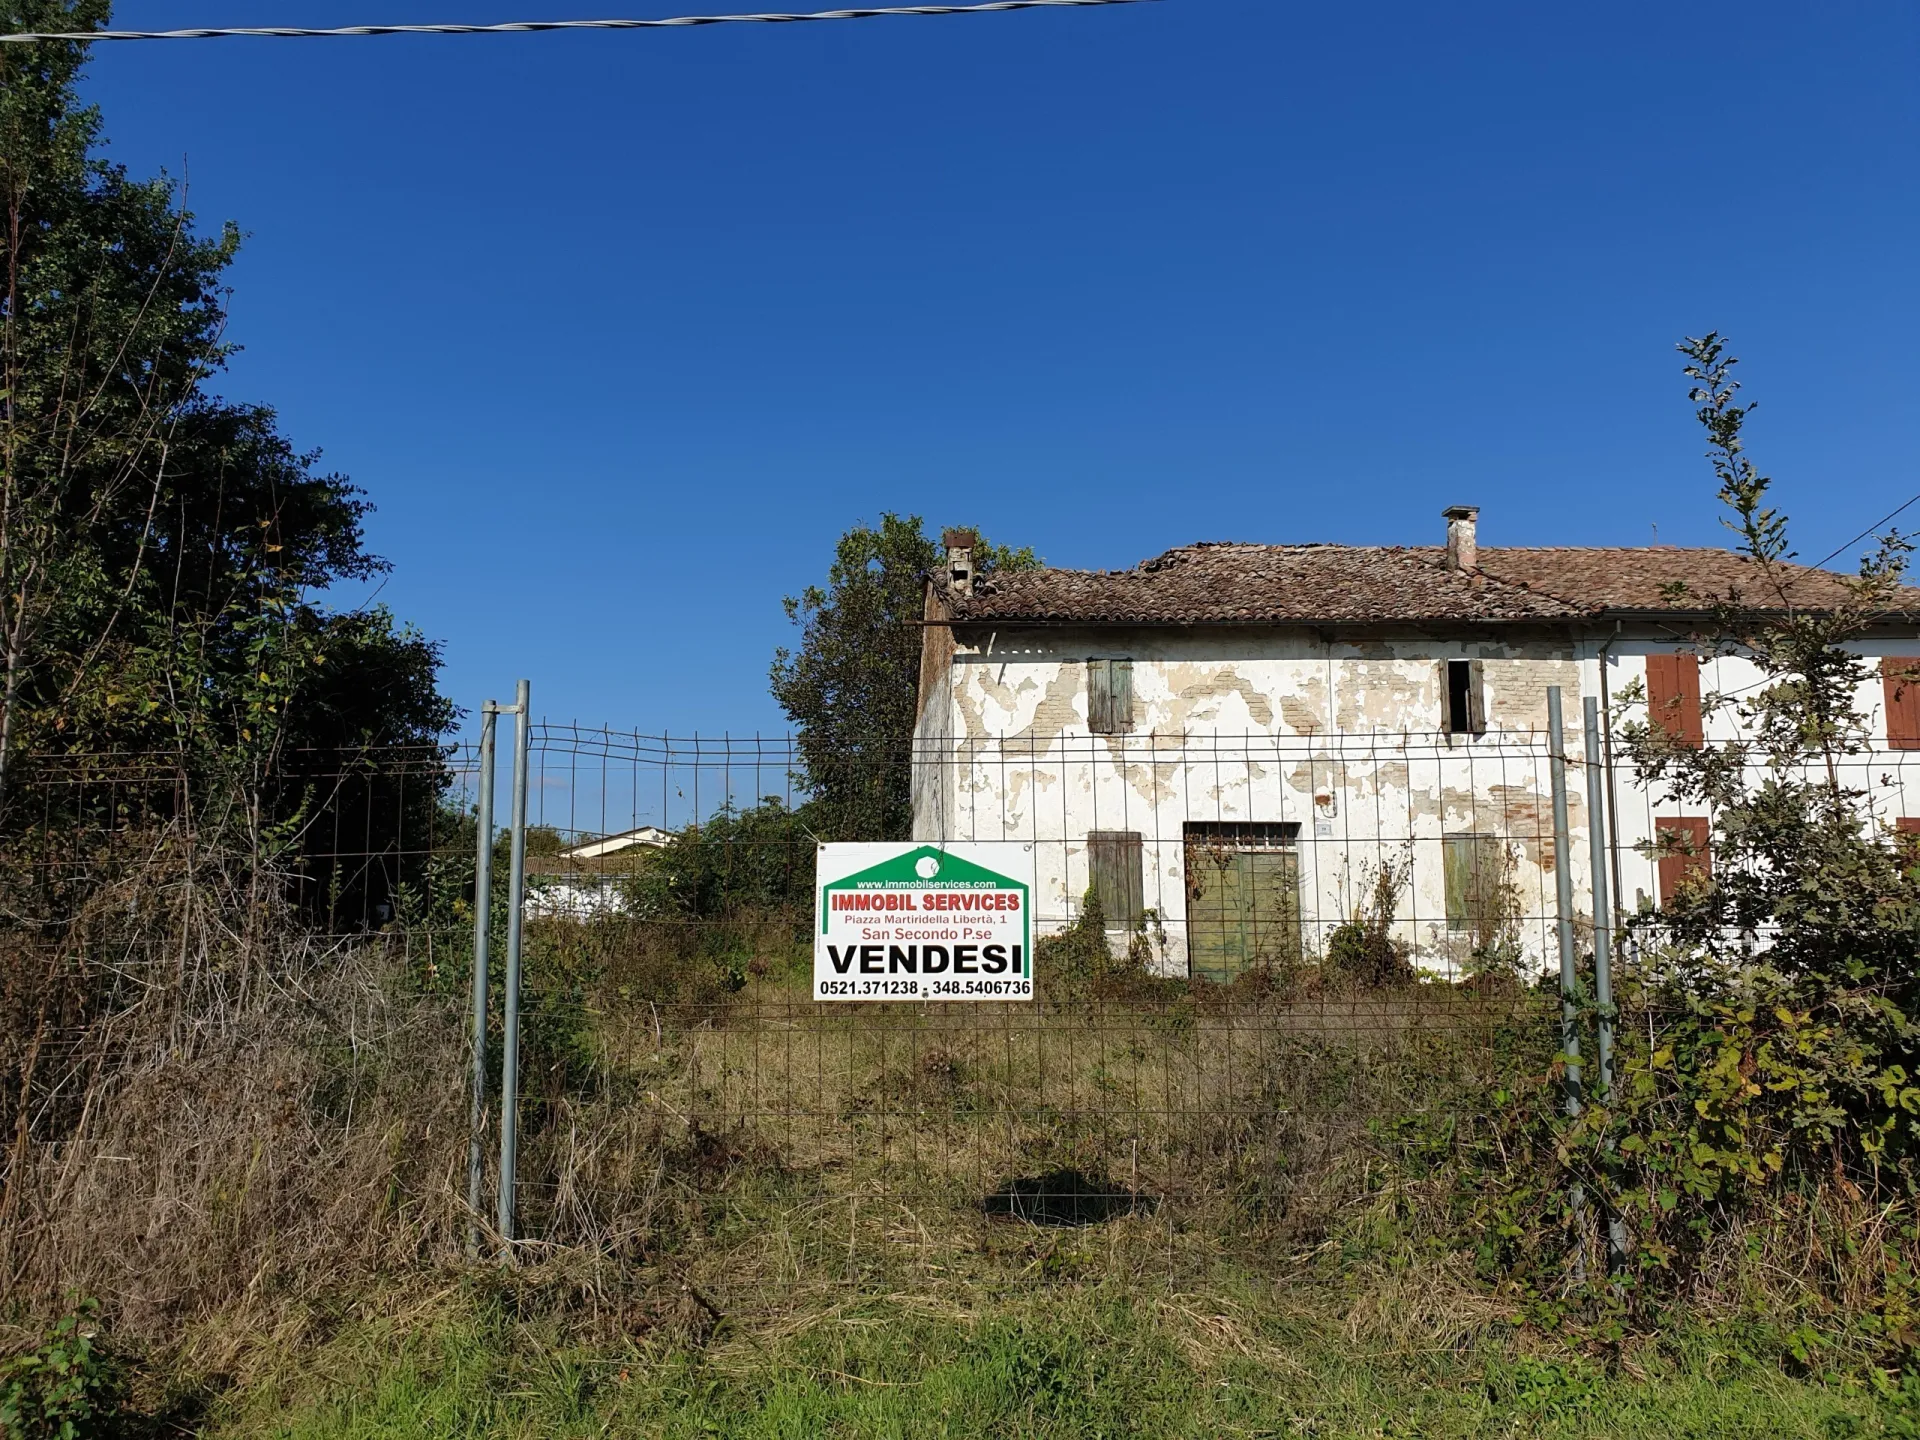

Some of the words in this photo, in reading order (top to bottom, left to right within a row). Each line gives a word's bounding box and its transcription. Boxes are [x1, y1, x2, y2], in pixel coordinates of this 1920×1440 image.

[857, 879, 996, 889] www.immobilservices.com
[832, 894, 917, 911] IMMOBIL
[922, 894, 1020, 911] SERVICES
[844, 915, 881, 924] Piazza
[884, 915, 949, 924] Martiridella
[953, 914, 996, 925] Libertà,
[999, 915, 1008, 924] 1
[862, 928, 890, 940] San
[895, 928, 959, 940] Secondo
[963, 928, 992, 940] P.se
[827, 945, 1022, 974] VENDESI
[820, 981, 918, 994] 0521.371238
[933, 981, 1030, 994] 348.5406736
